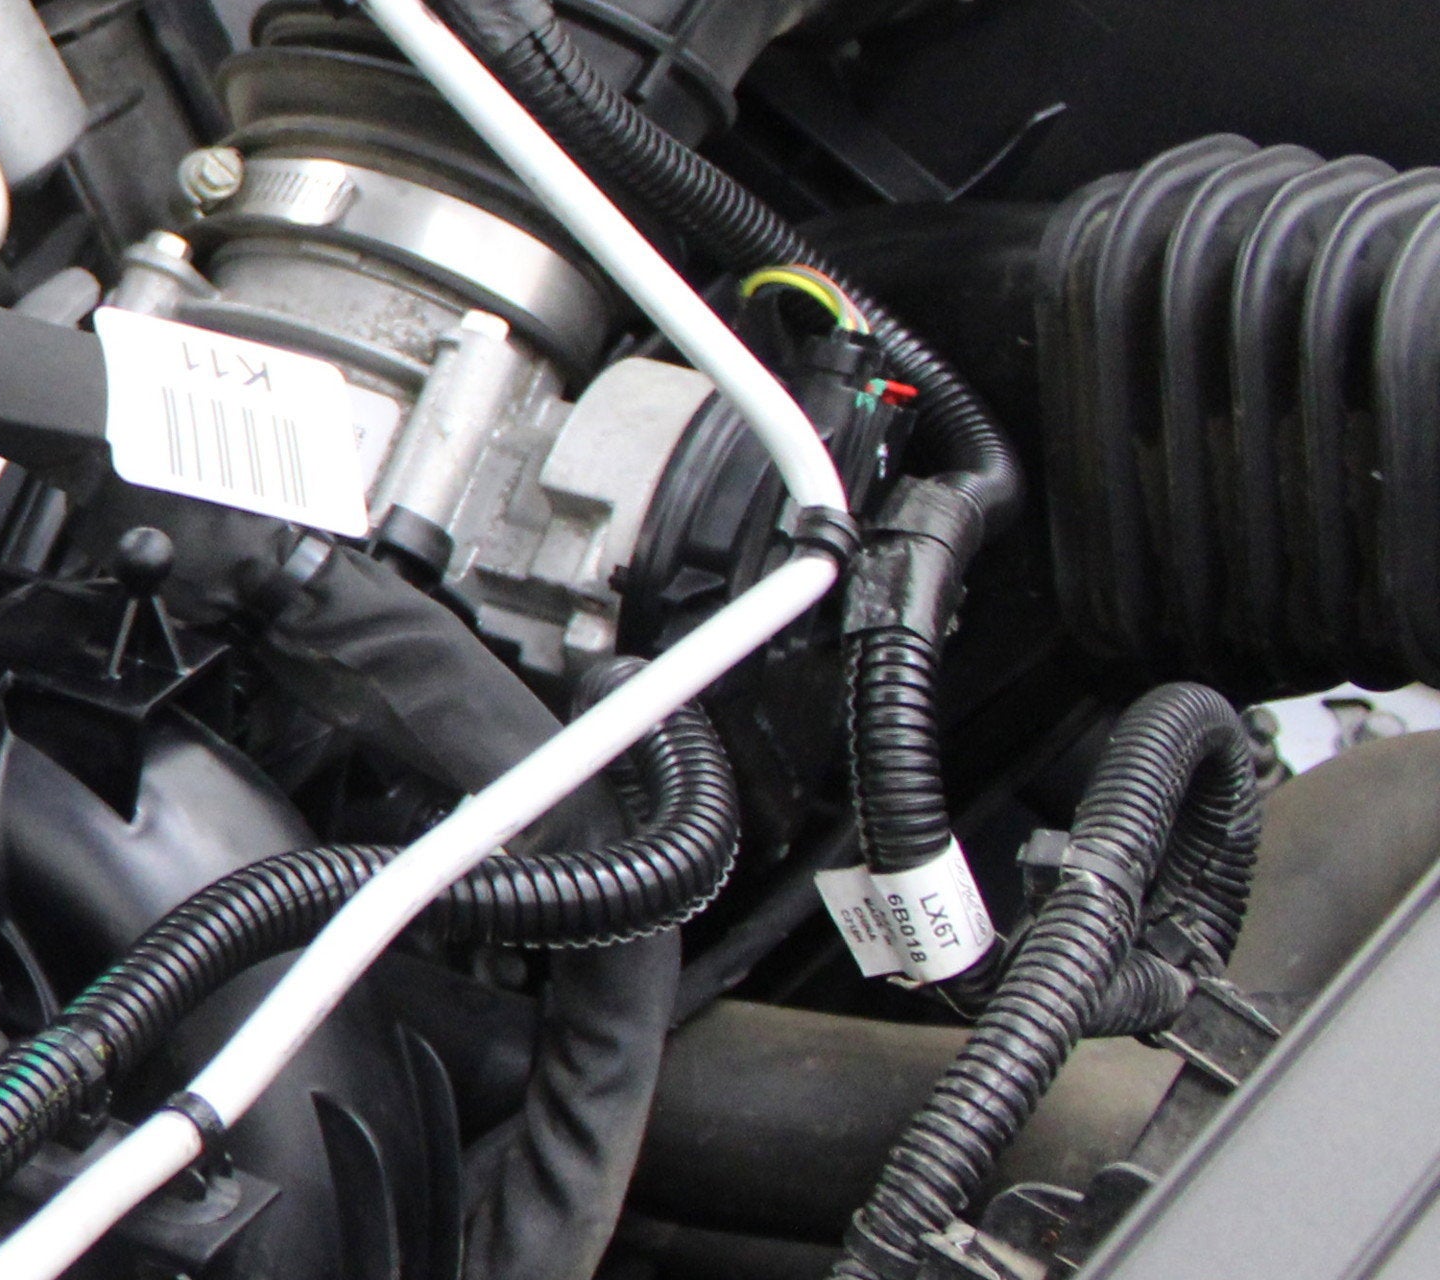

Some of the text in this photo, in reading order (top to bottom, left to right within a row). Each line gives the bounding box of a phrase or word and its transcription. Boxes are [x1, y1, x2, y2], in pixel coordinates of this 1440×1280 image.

[183, 342, 272, 392] K11
[886, 894, 928, 964] 6B018
[919, 892, 961, 949] LX6T
